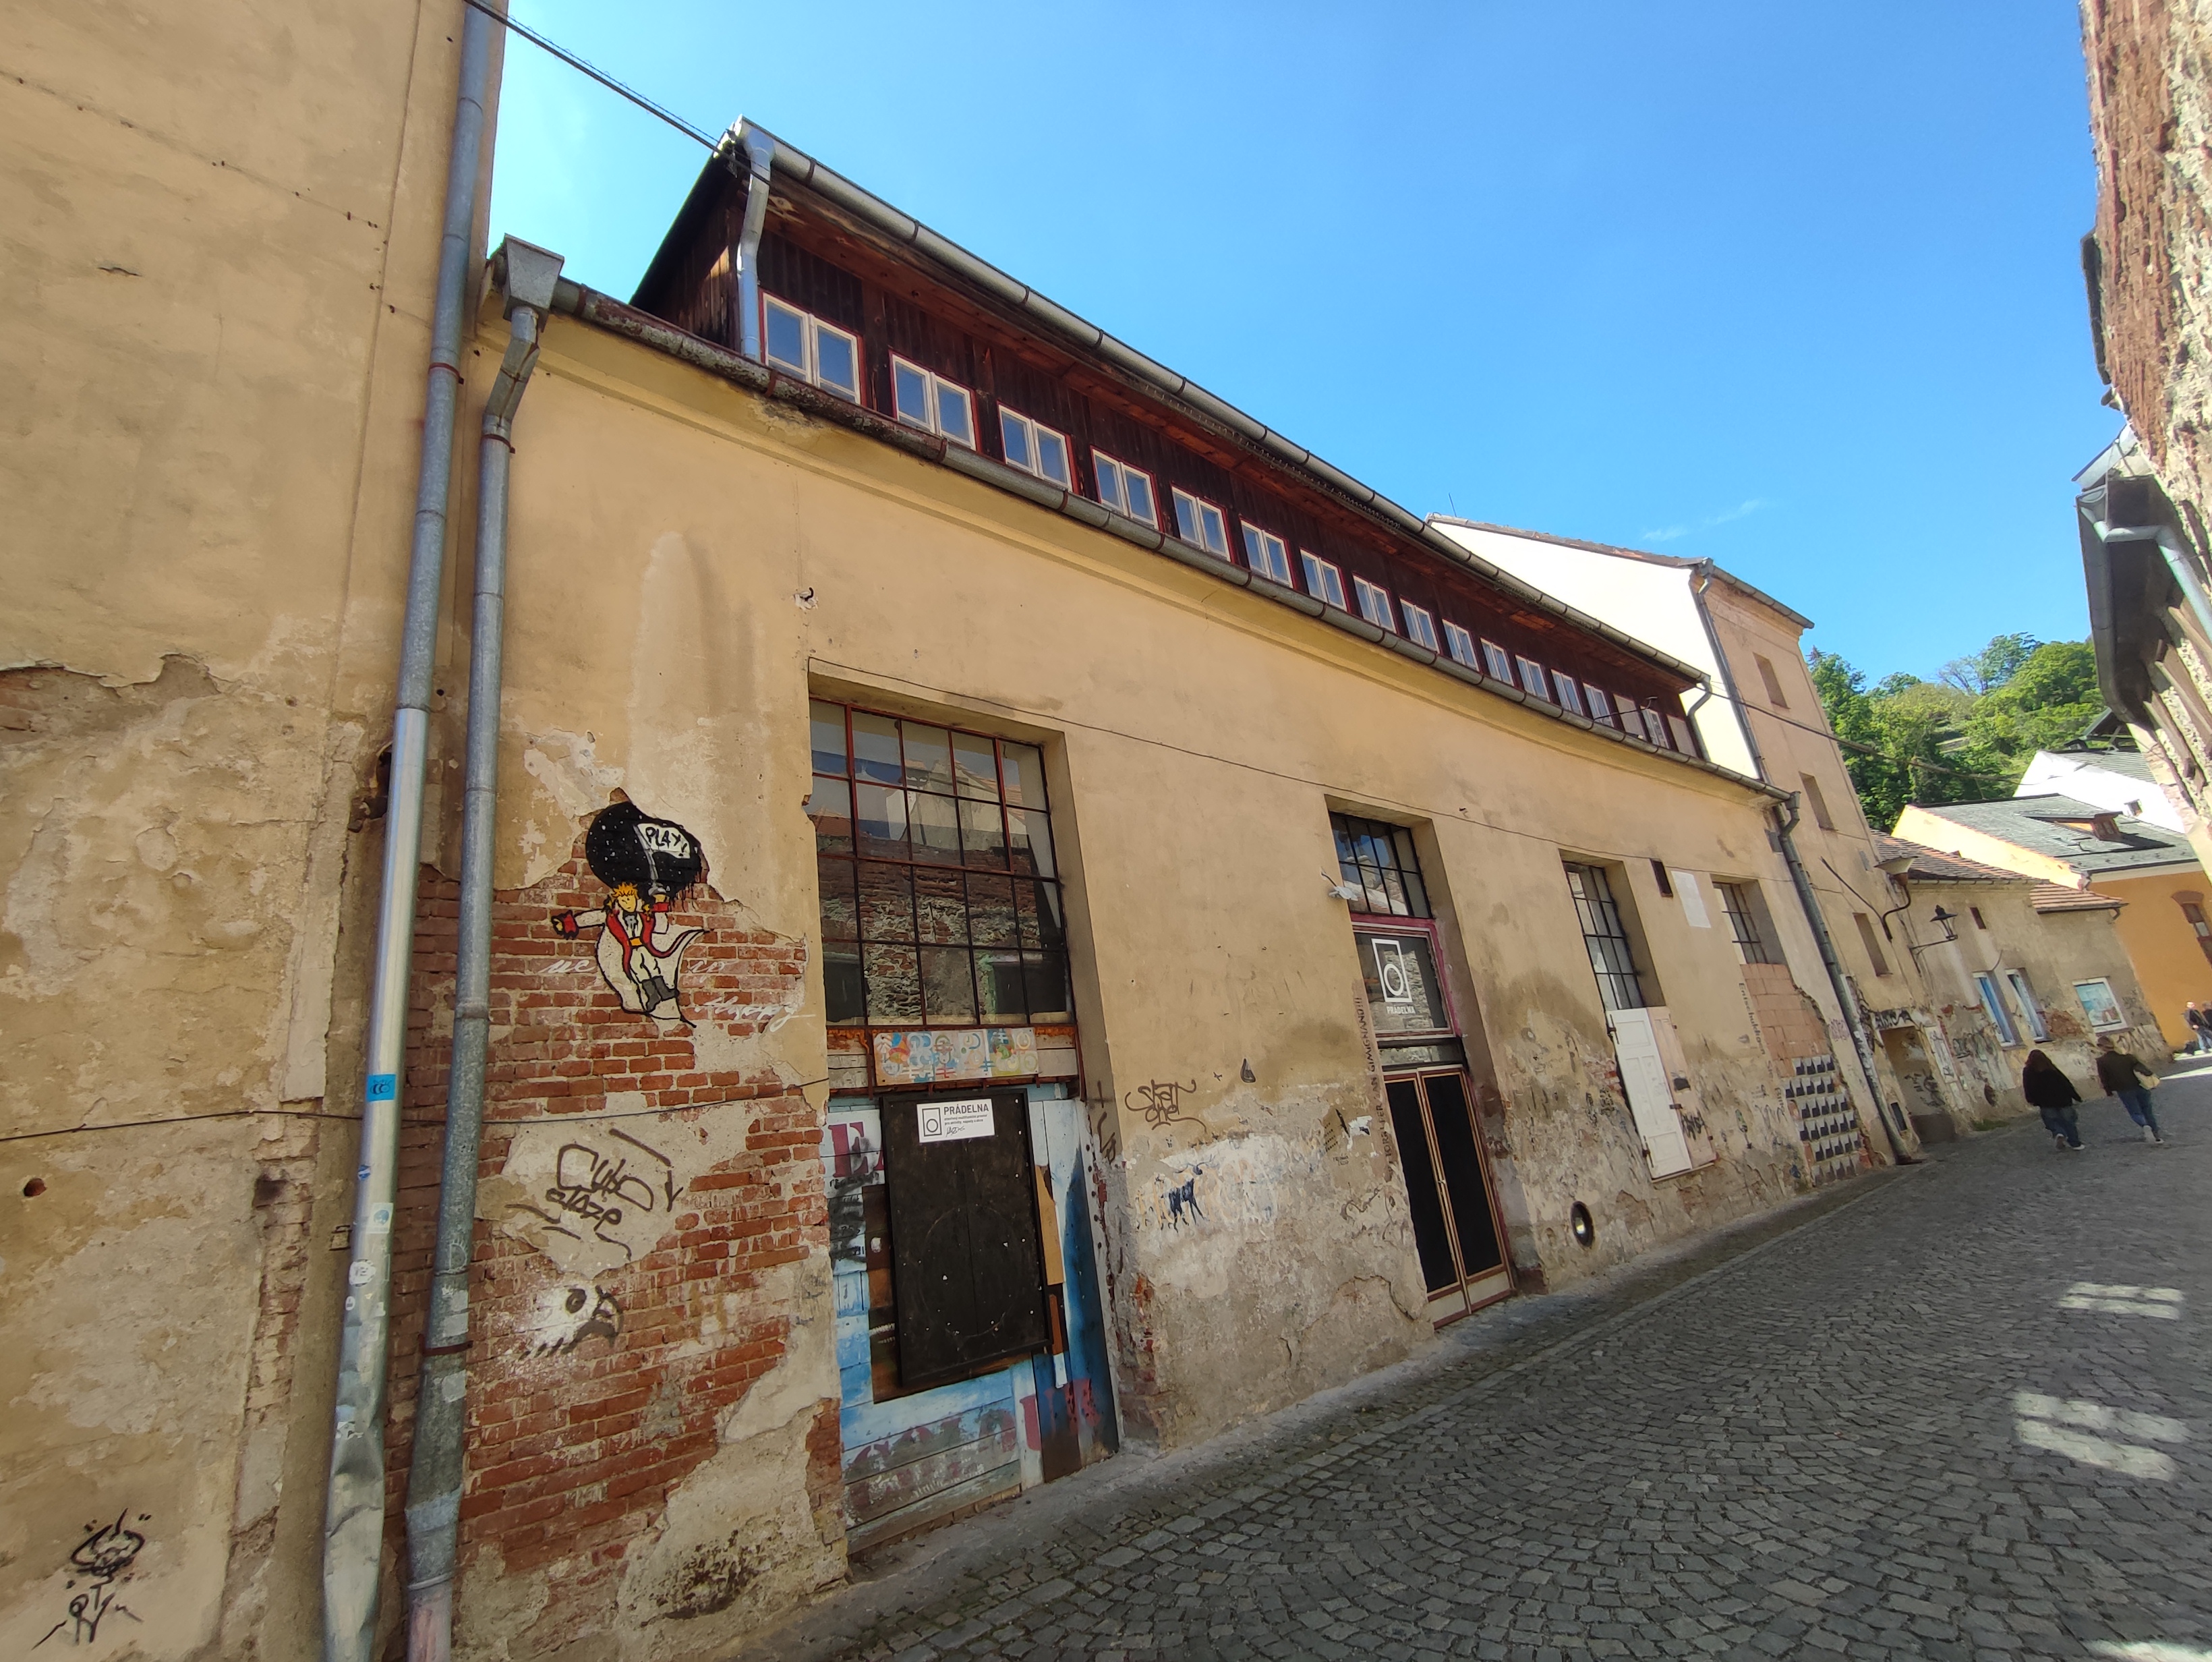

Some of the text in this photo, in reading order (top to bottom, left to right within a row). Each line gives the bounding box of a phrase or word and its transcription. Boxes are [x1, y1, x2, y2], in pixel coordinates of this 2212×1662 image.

[645, 826, 687, 857] PLAY!
[1387, 1005, 1416, 1014] PRÁDELNA
[943, 1104, 989, 1115] PRÁDELNA
